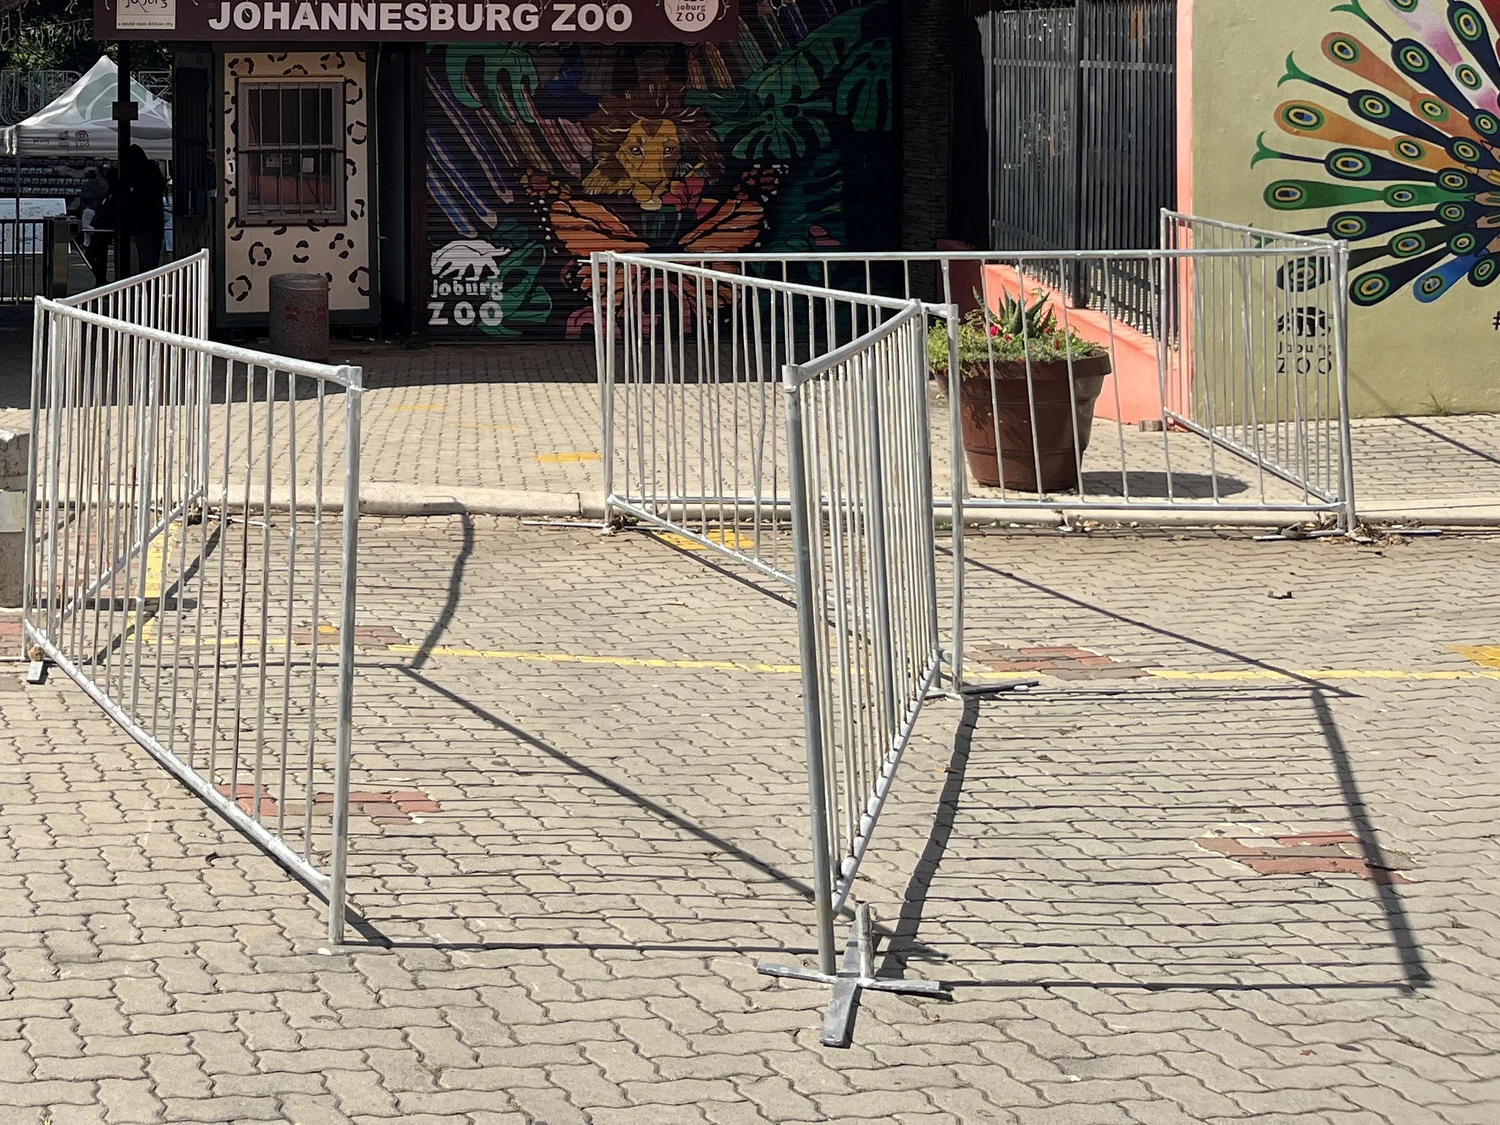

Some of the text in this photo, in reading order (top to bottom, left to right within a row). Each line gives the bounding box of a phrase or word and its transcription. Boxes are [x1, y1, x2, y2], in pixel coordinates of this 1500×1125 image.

[208, 1, 633, 32] JOHANNESBURG ZOO
[676, 12, 706, 22] ZOO
[427, 301, 503, 326] ZOO
[1277, 357, 1333, 374] ZOO
